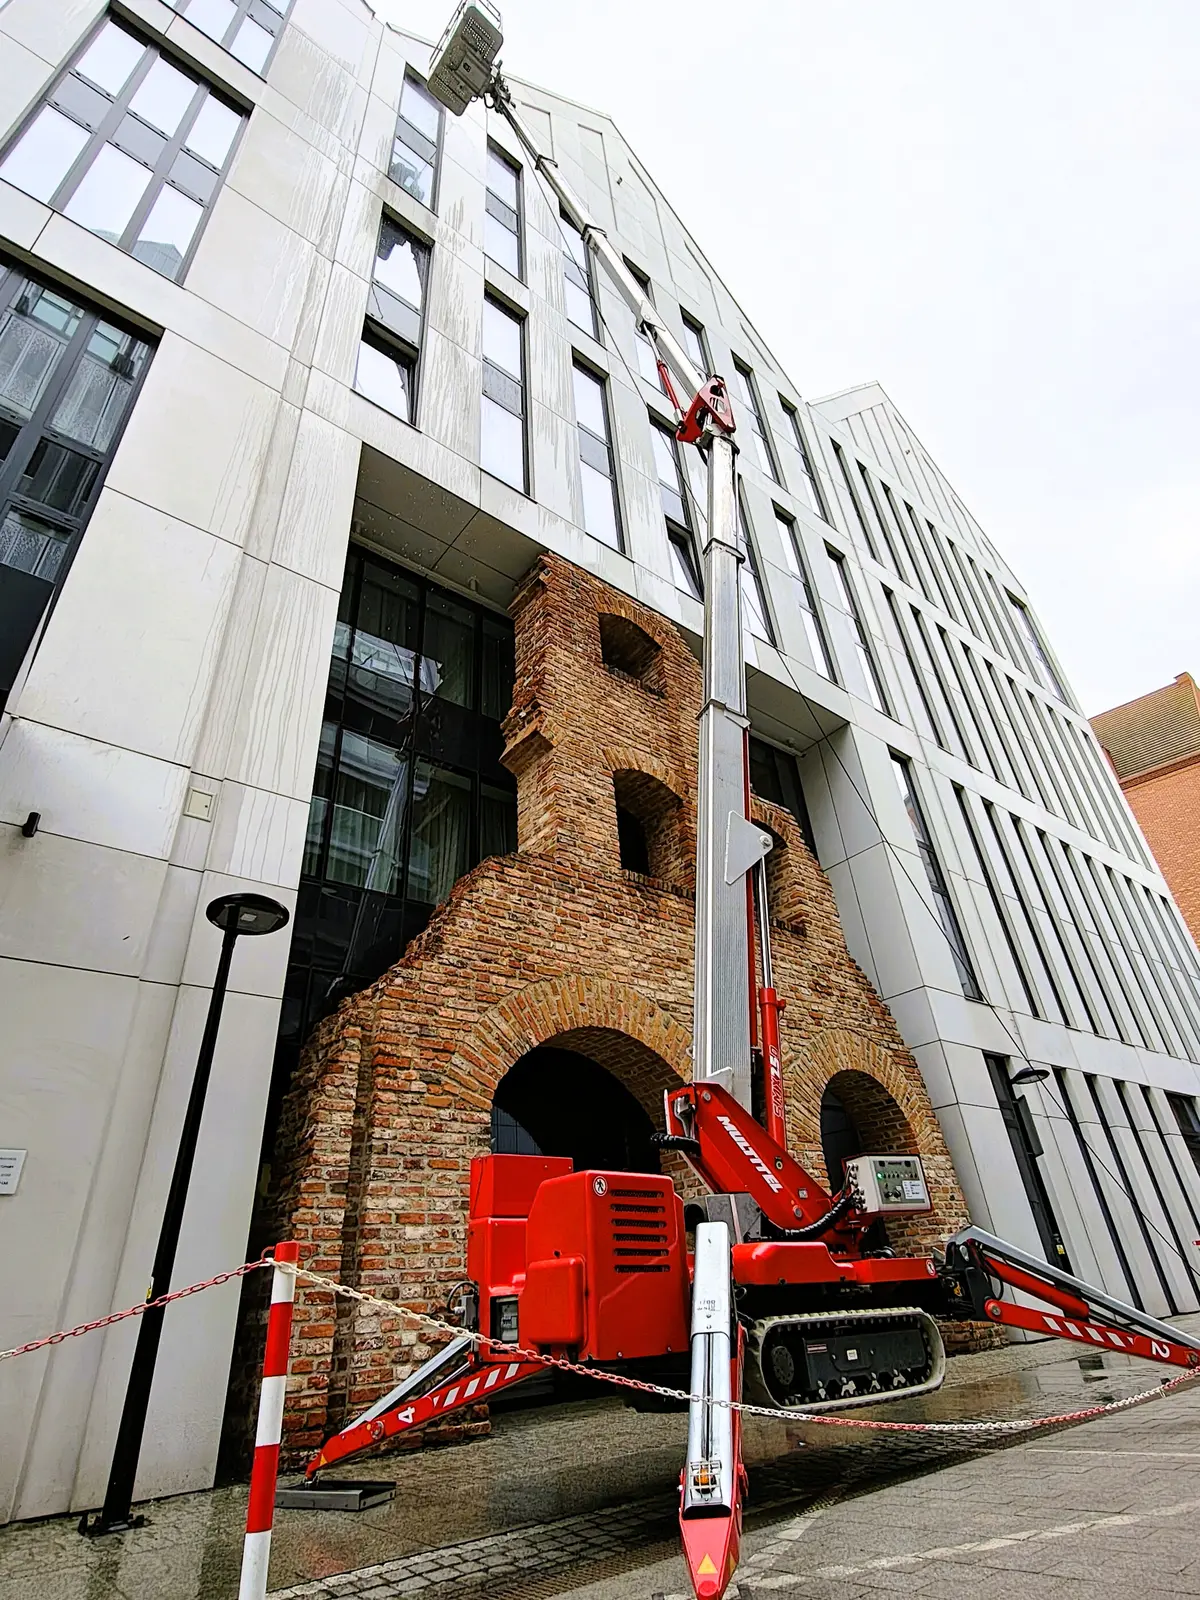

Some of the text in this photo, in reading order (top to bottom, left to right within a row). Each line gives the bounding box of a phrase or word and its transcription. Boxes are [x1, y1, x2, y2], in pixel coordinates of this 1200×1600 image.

[716, 1116, 783, 1193] MULTITEL
[1152, 1340, 1170, 1358] 2
[398, 1406, 415, 1424] 4
